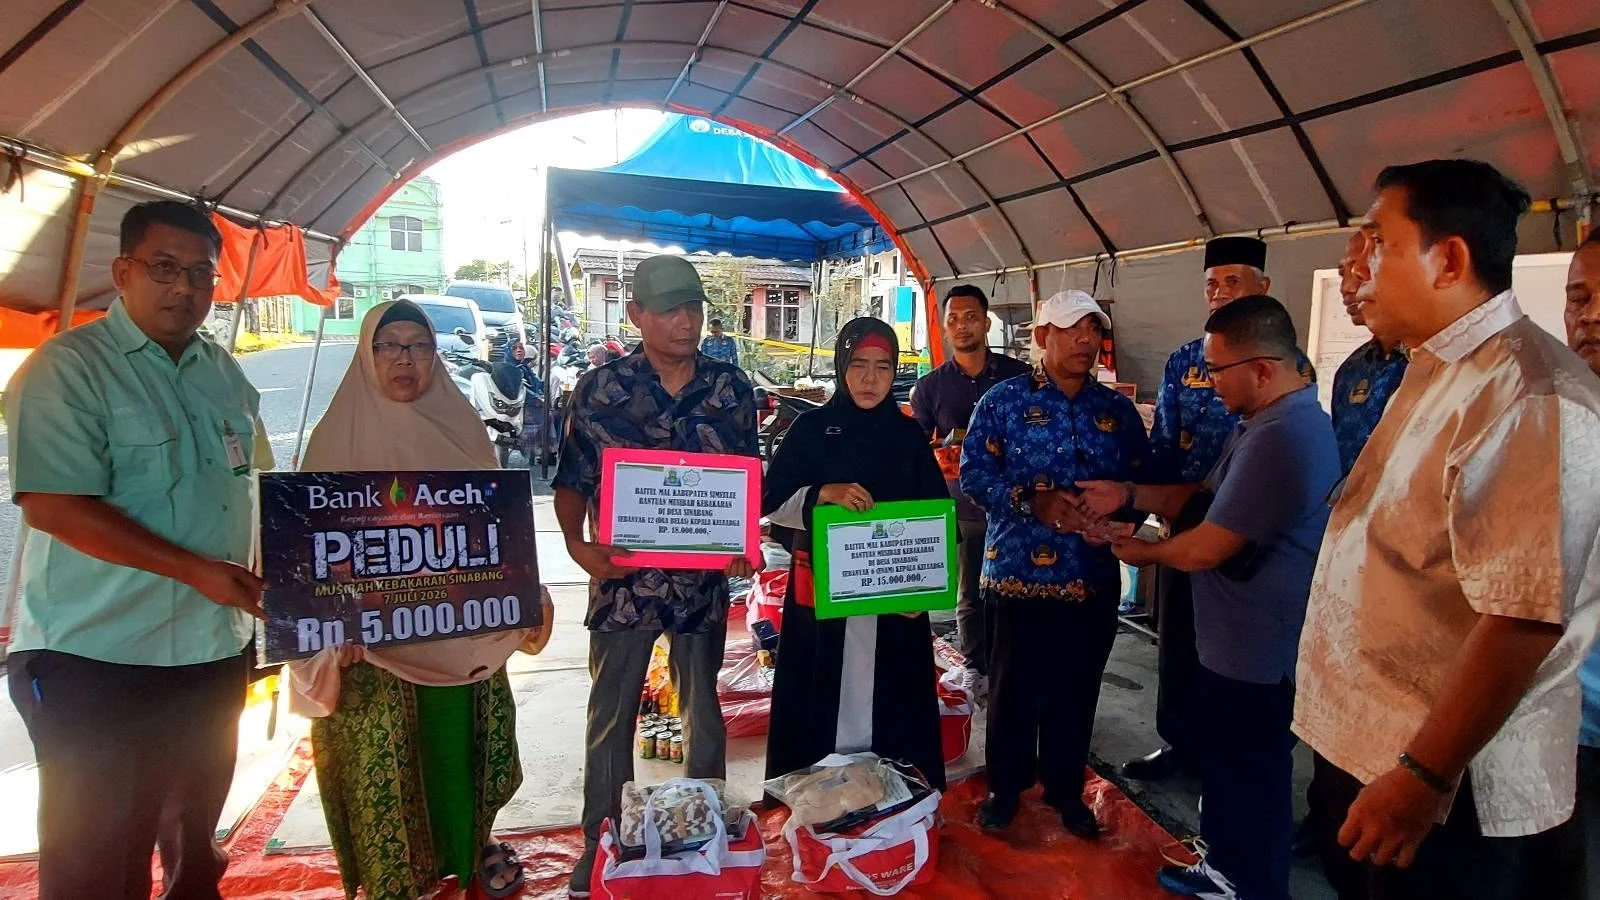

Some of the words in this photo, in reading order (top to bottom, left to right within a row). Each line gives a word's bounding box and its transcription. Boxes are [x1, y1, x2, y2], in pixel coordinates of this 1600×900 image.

[309, 485, 382, 509] Bank
[413, 483, 483, 506] Aceh
[673, 489, 708, 497] KABUPATEN
[401, 513, 416, 521] dan
[314, 523, 499, 579] PEDULI
[375, 577, 446, 591] KEBAKARAN
[449, 571, 504, 584] SINABANG
[861, 578, 875, 586] RP.
[877, 574, 926, 585] 15.000.000,-
[384, 594, 391, 604] 7
[393, 591, 417, 603] JULI
[420, 590, 448, 601] 2026
[361, 595, 521, 644] 5.000.000
[881, 862, 913, 879] WARE
